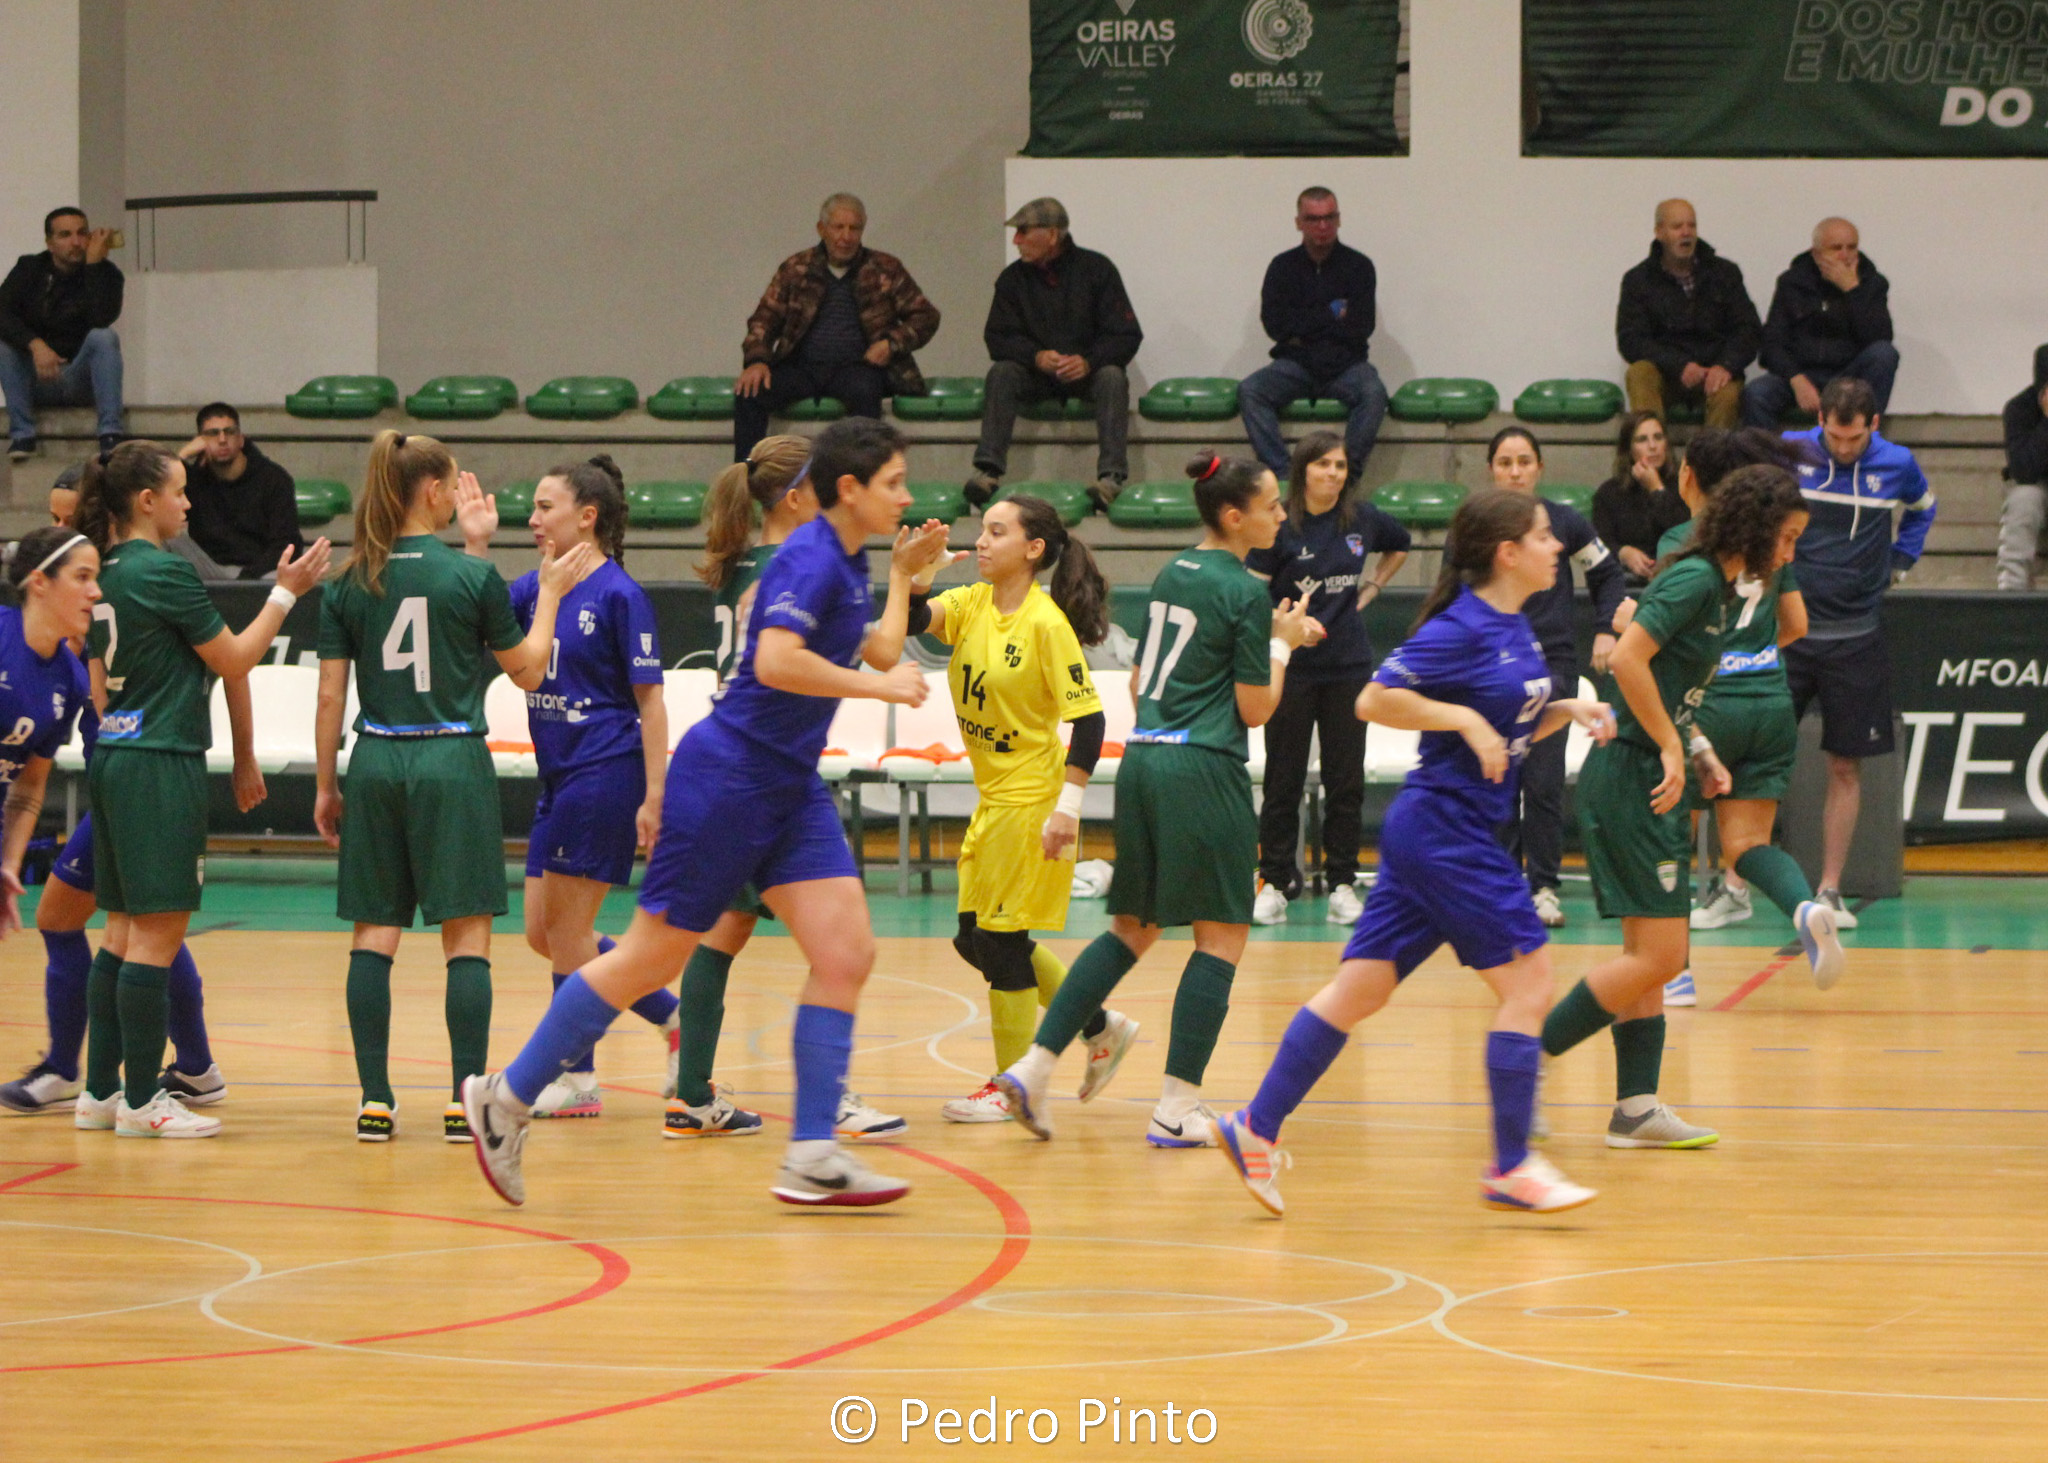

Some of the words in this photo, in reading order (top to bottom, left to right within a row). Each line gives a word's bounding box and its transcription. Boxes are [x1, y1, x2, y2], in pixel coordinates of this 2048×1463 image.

[1077, 19, 1176, 43] OEIRAS
[1793, 0, 1922, 41] DOS
[1077, 44, 1176, 68] VALLEY
[1784, 40, 1825, 82] E
[1229, 72, 1298, 88] OEIRAS
[1302, 72, 1324, 88] 27
[1940, 86, 2034, 128] DO
[382, 597, 431, 692] 4
[1137, 600, 1198, 701] 17
[962, 664, 987, 711] 14
